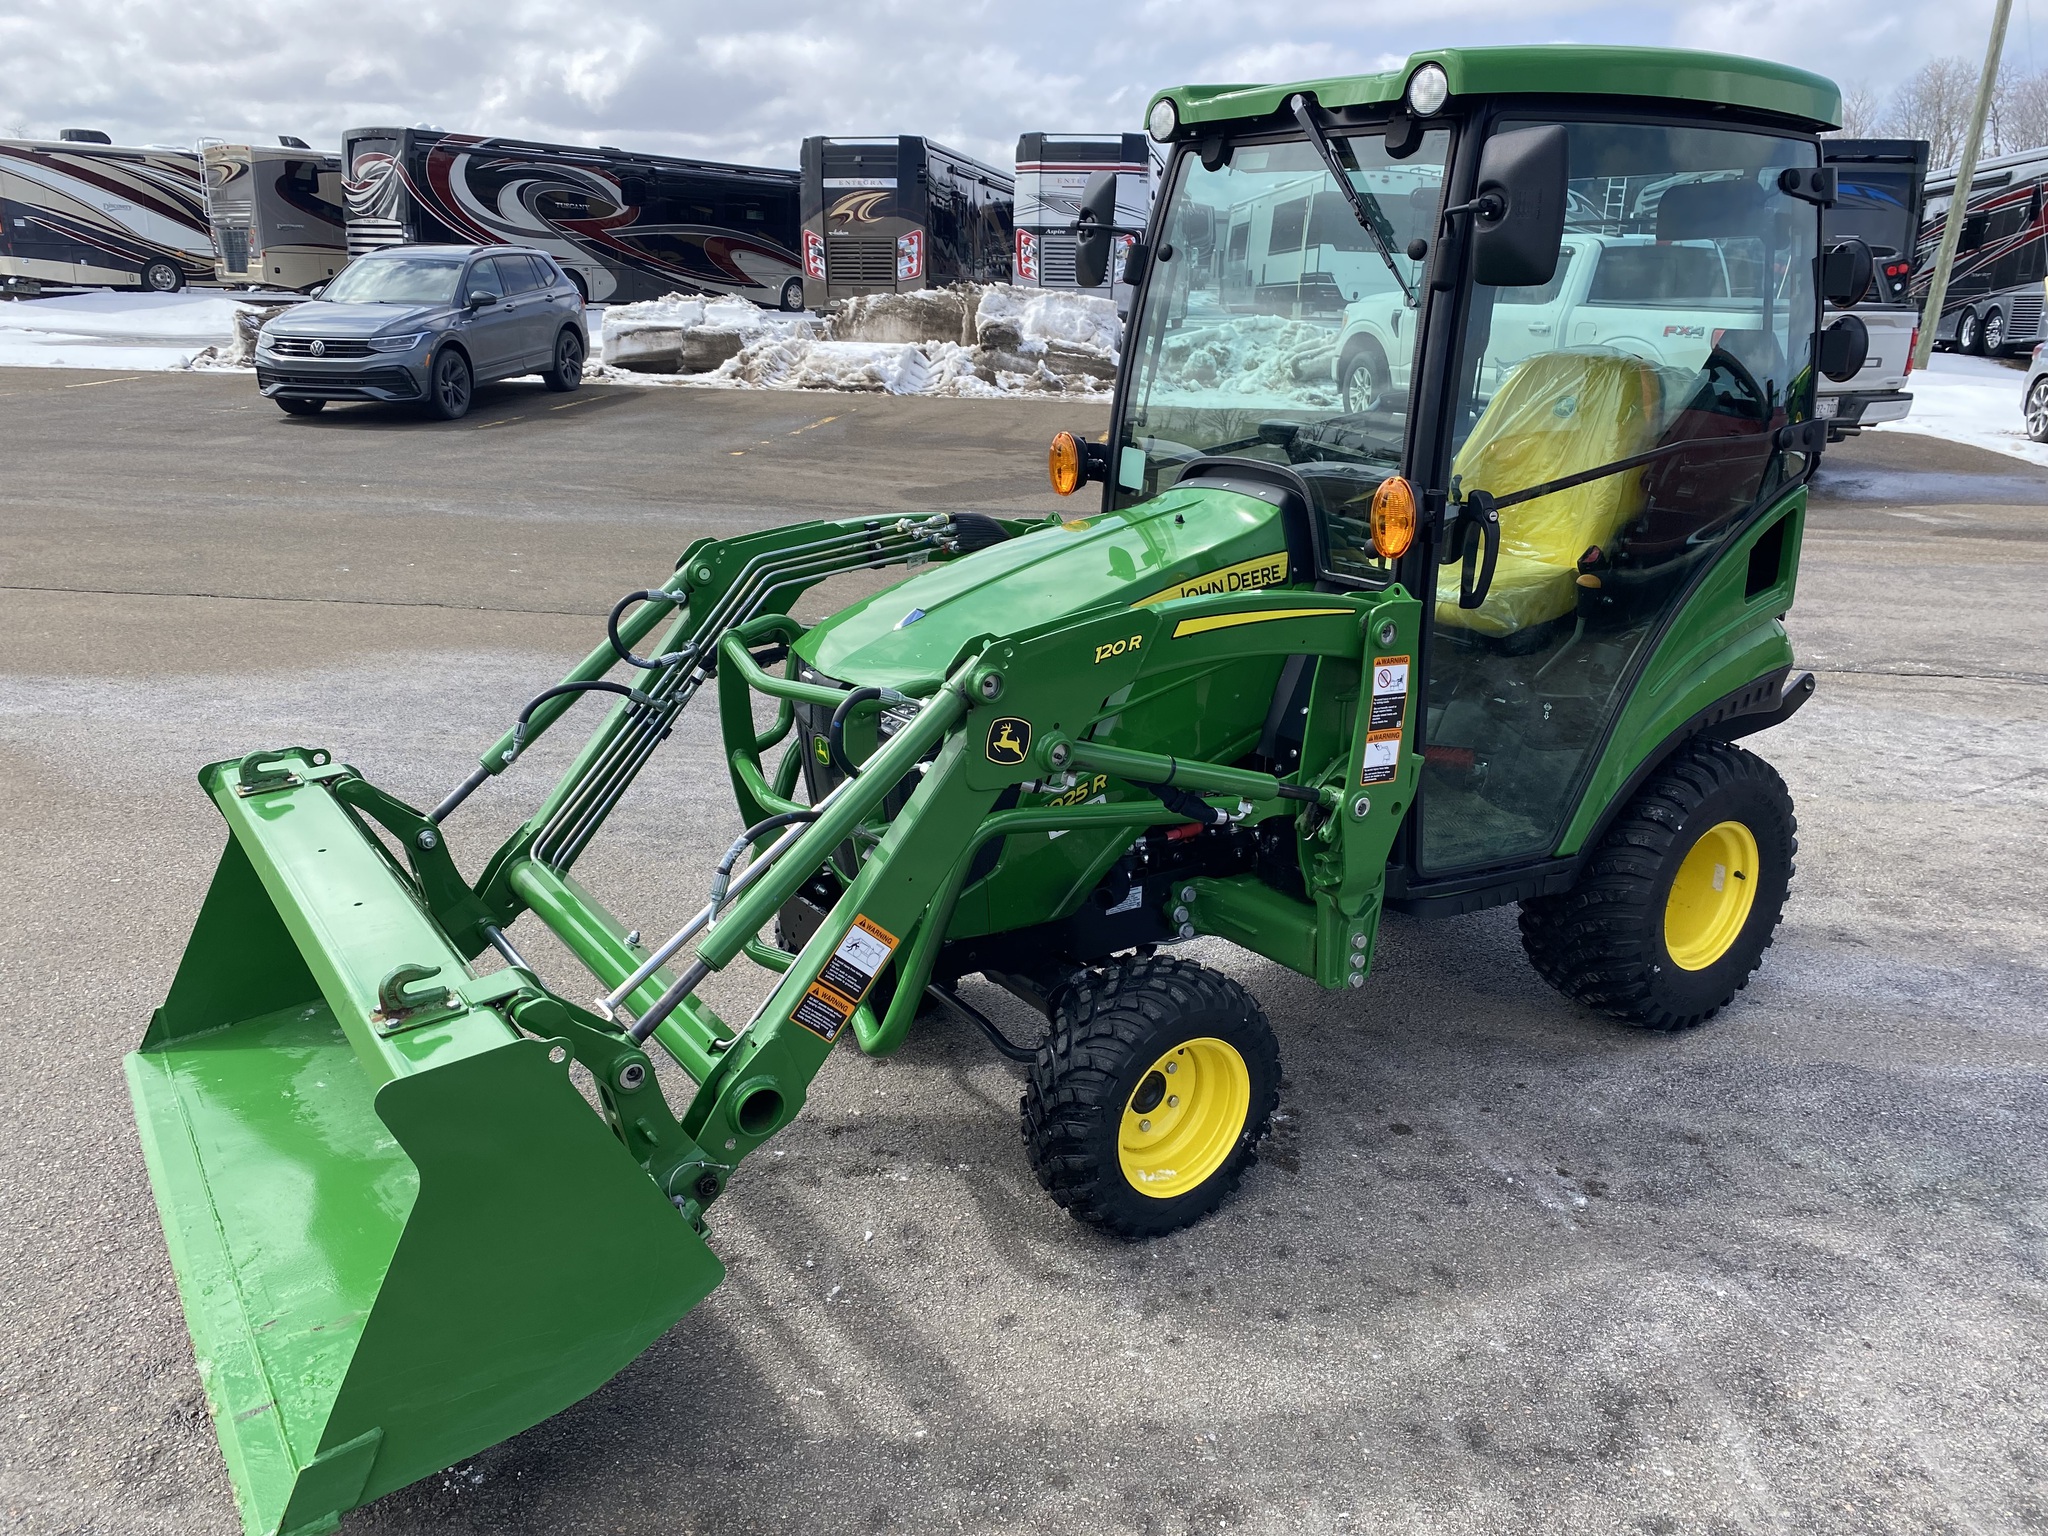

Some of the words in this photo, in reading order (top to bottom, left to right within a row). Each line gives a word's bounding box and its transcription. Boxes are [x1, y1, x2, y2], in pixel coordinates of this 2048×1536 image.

[555, 202, 590, 210] TUSCANY
[1663, 325, 1705, 338] FX4
[1181, 579, 1224, 599] JOHN
[1227, 563, 1281, 592] DEERE
[1382, 656, 1408, 665] WARNING
[1373, 732, 1400, 741] WARNING
[866, 923, 893, 945] WARNING
[821, 991, 849, 1013] WARNING
